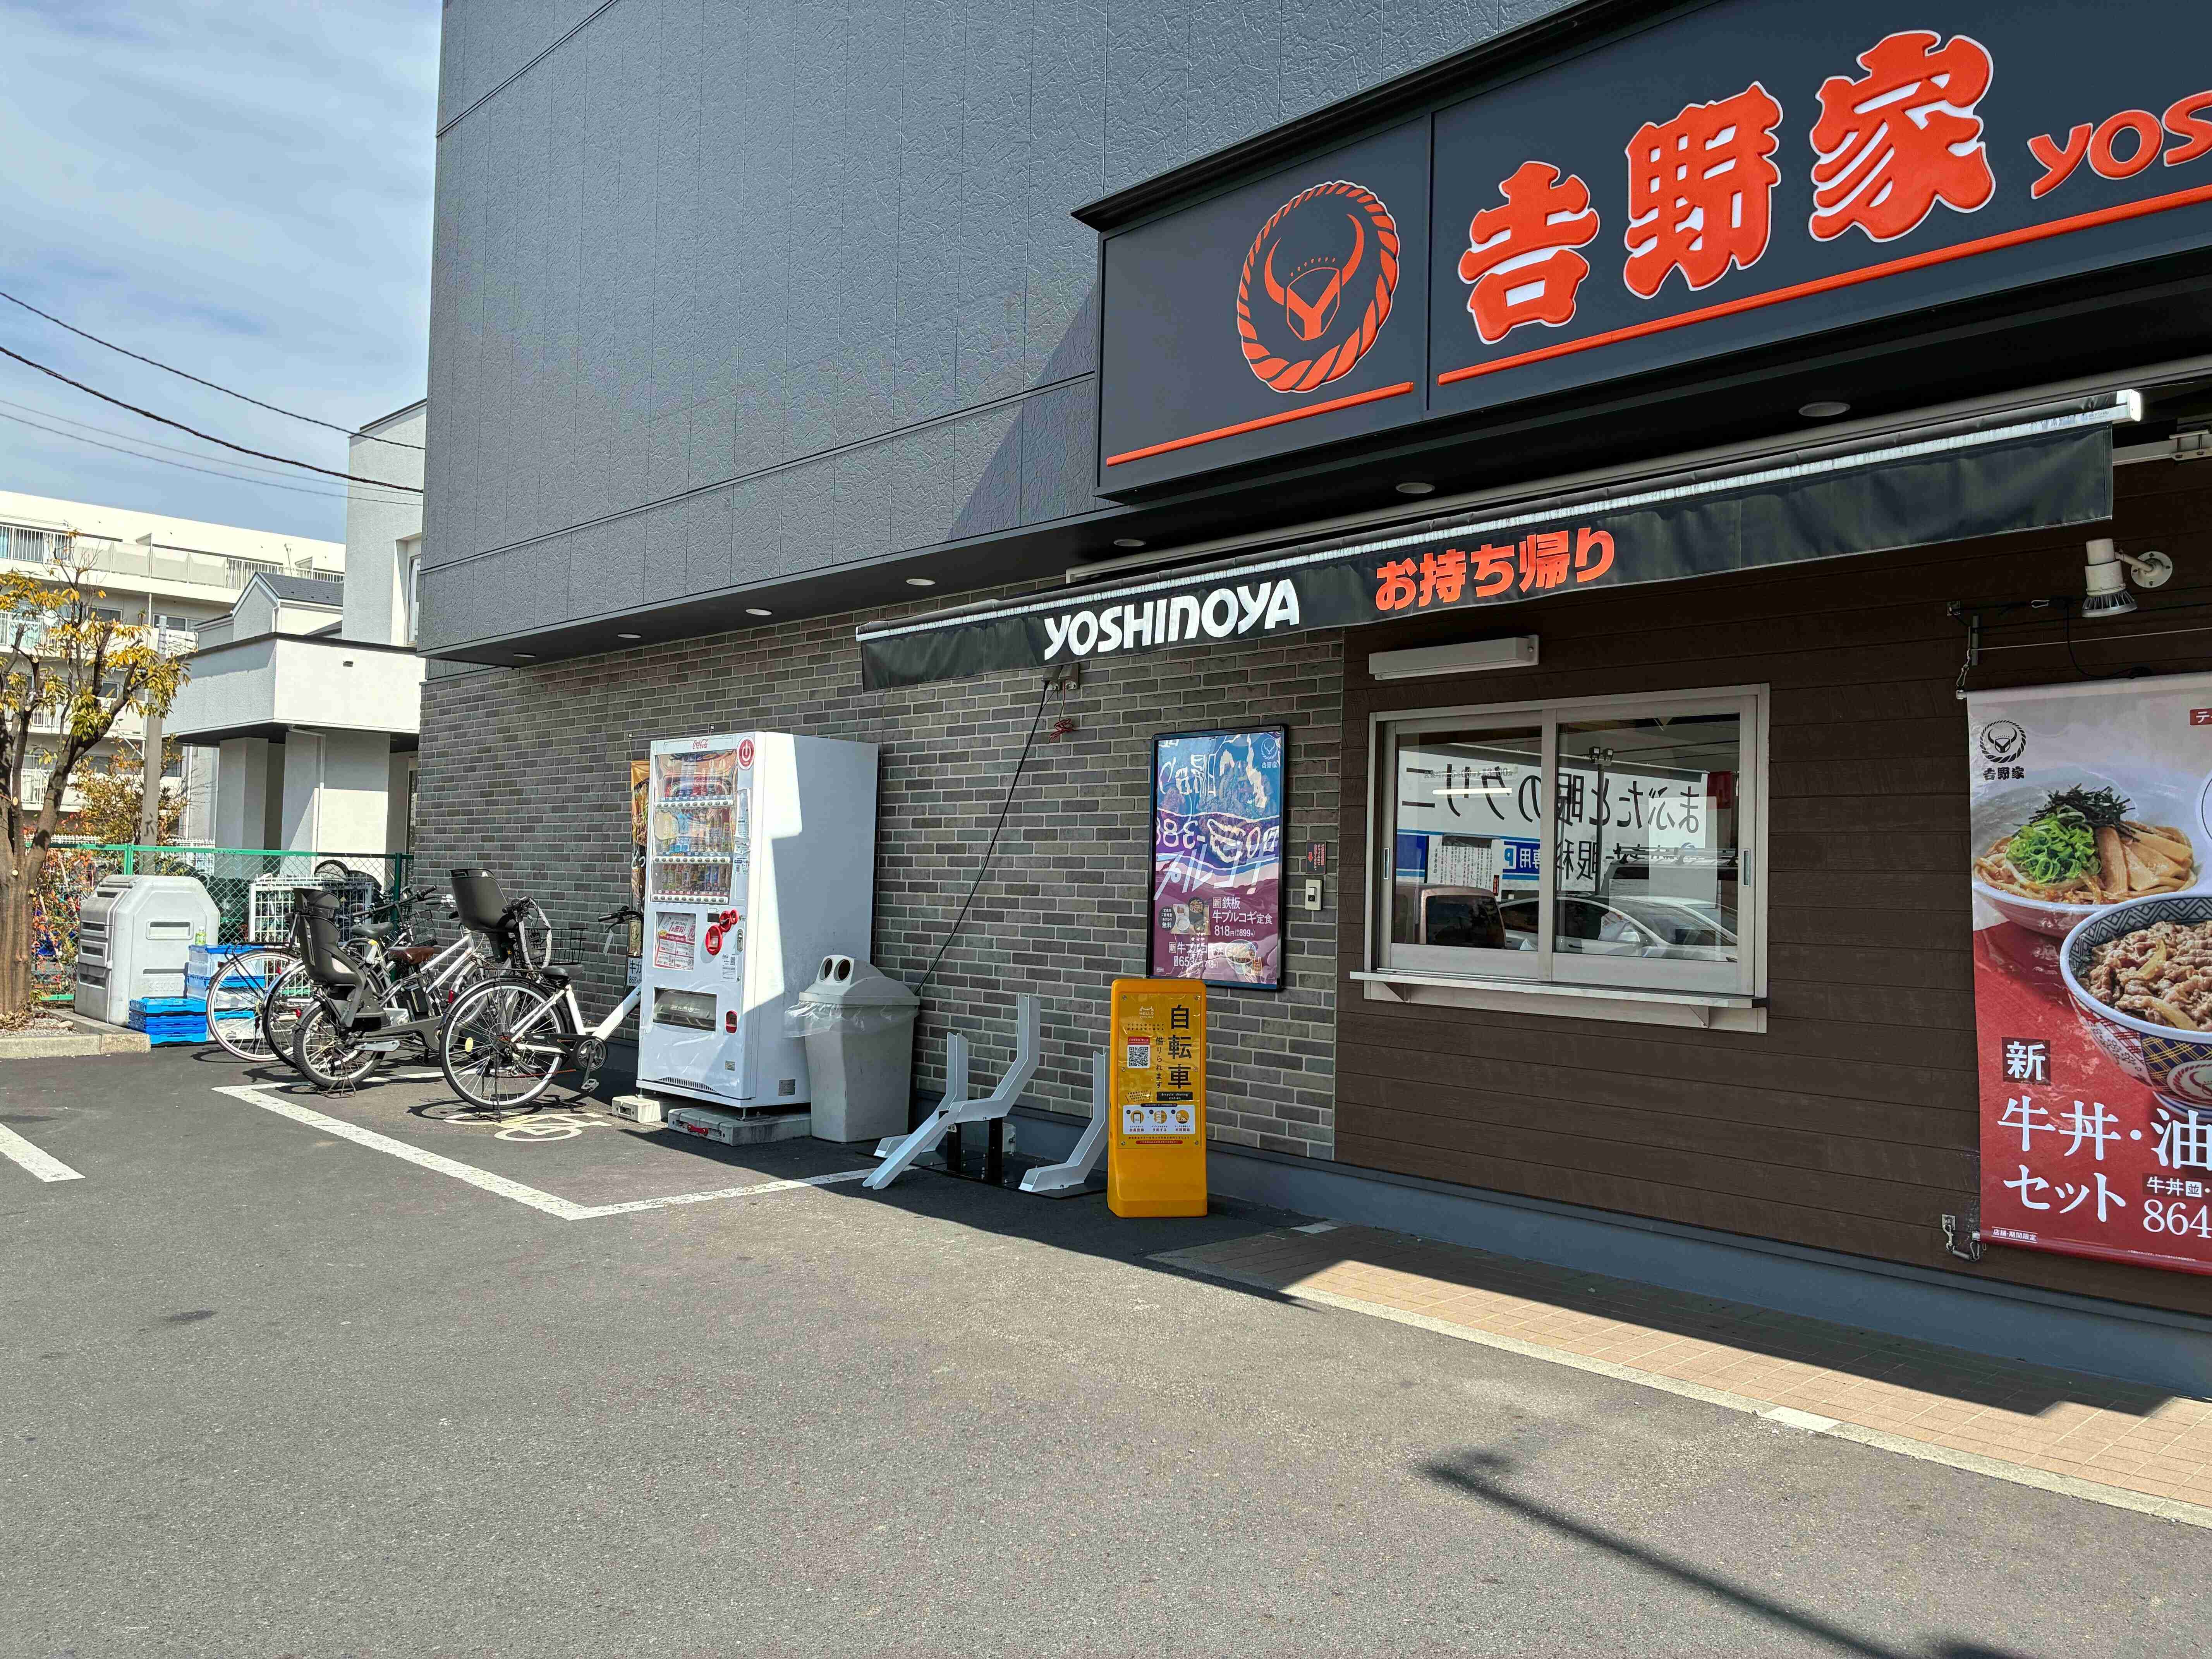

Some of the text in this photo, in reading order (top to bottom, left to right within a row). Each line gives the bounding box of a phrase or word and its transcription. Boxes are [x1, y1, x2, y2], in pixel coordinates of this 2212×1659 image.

[1458, 29, 1996, 345] 吉野家
[1374, 528, 1616, 612] お持ち帰り
[1044, 579, 1300, 660] YOSHINOYA
[1983, 766, 2025, 780] 吉野家
[1212, 909, 1273, 924] 牛プルコギ定食
[1222, 896, 1240, 909] 鉄板
[1168, 1004, 1192, 1089] 自転車
[2006, 1041, 2045, 1080] 新
[2003, 1164, 2126, 1222] セット
[2143, 1199, 2212, 1238] 864
